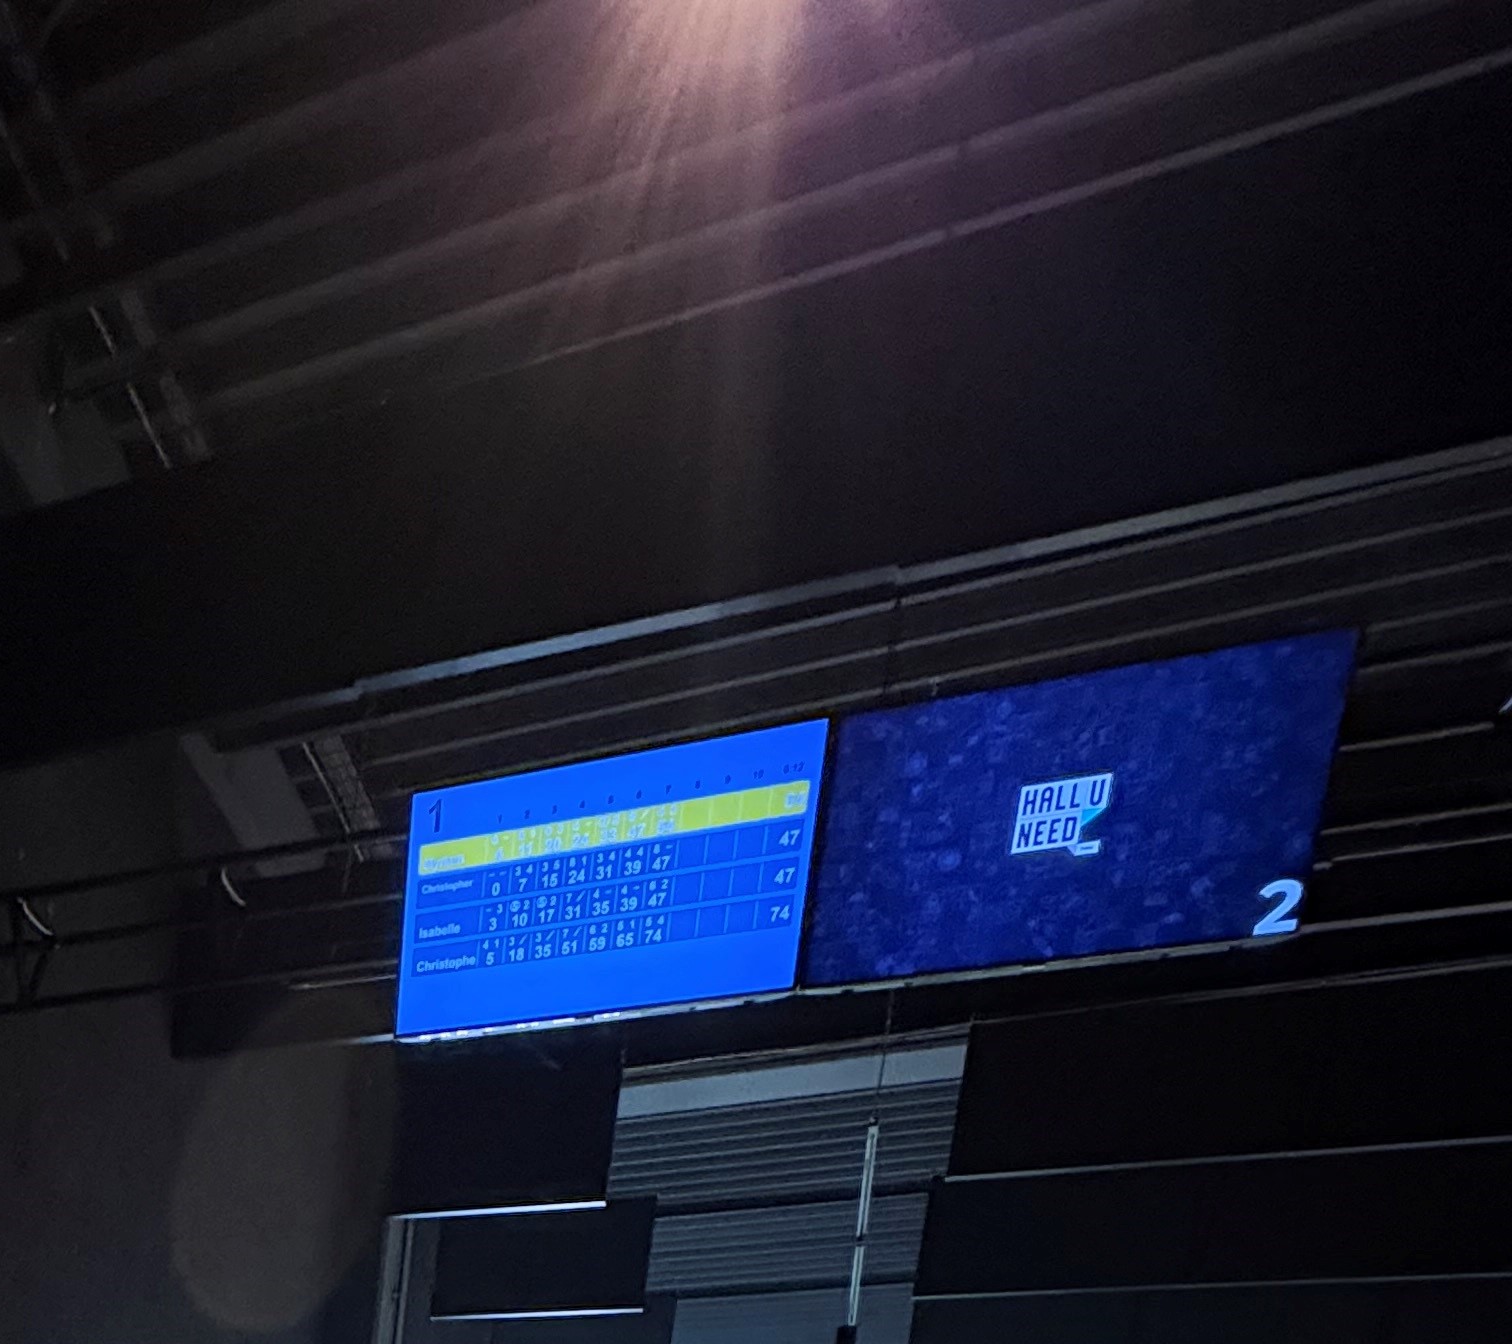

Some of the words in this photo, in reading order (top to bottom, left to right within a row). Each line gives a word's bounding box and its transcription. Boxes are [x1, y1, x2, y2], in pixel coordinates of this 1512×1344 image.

[1021, 782, 1080, 816] HALL
[1089, 779, 1106, 806] U
[428, 799, 442, 832] 1
[778, 828, 800, 846] 47
[1016, 816, 1078, 849] NEED
[492, 882, 501, 896] 0
[518, 878, 528, 892] 7
[542, 873, 558, 888] 15
[568, 868, 586, 885] 24
[596, 864, 612, 880] 31
[624, 860, 642, 875] 39
[652, 855, 671, 870] 47
[515, 866, 522, 876] 3
[526, 864, 533, 874] 4
[582, 855, 587, 866] 1
[597, 853, 604, 863] 3
[608, 851, 616, 861] 4
[624, 847, 632, 858] 4
[637, 846, 644, 856] 4
[774, 867, 795, 884] 47
[421, 879, 473, 894] Christopher
[496, 904, 503, 914] 3
[566, 893, 572, 903] 7
[593, 888, 600, 899] 4
[621, 884, 628, 894] 4
[662, 879, 668, 889] 2
[489, 918, 497, 931] 3
[512, 913, 528, 927] 10
[538, 909, 555, 923] 17
[564, 907, 580, 920] 31
[592, 900, 610, 916] 35
[620, 897, 638, 912] 39
[648, 892, 666, 907] 47
[770, 905, 790, 922] 74
[1252, 878, 1303, 936] 2
[419, 923, 461, 939] Isabelle
[486, 952, 494, 965] 5
[508, 948, 524, 962] 18
[534, 945, 551, 959] 35
[562, 941, 578, 955] 51
[589, 936, 606, 951] 59
[616, 932, 634, 948] 65
[644, 928, 662, 944] 74
[509, 937, 515, 946] 3
[535, 932, 542, 942] 3
[562, 928, 569, 938] 7
[601, 923, 608, 933] 2
[630, 919, 636, 929] 1
[657, 915, 664, 925] 4
[416, 954, 476, 973] Christophe
